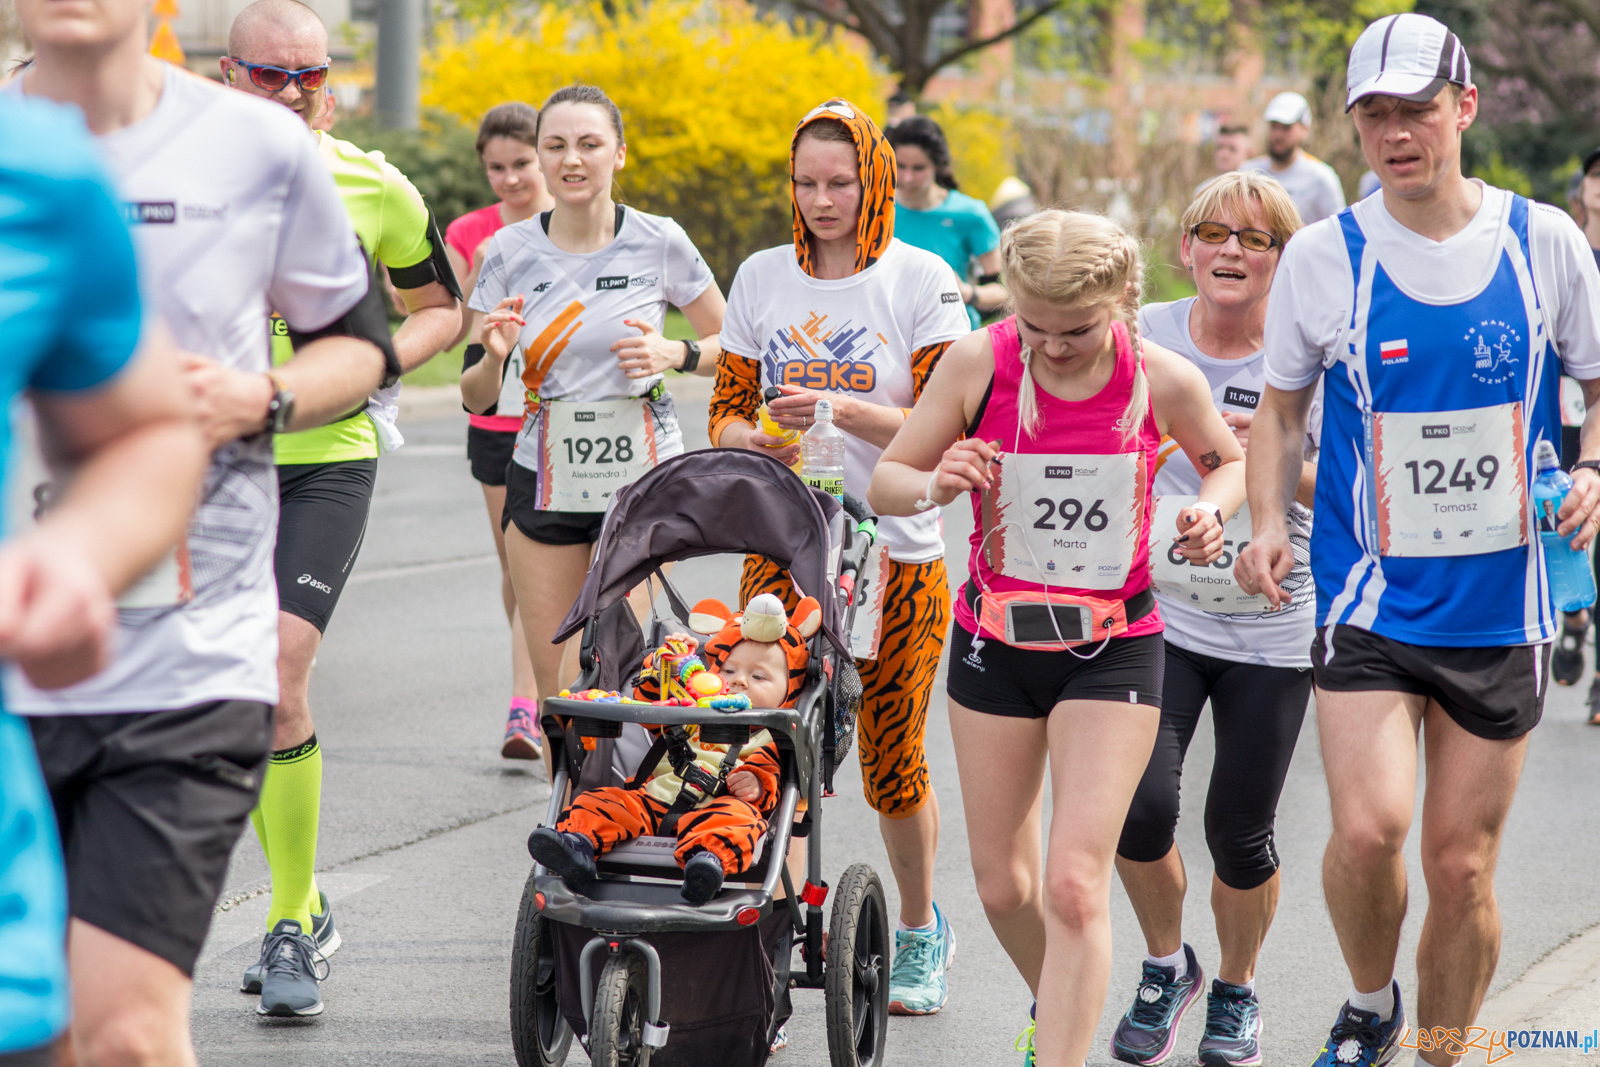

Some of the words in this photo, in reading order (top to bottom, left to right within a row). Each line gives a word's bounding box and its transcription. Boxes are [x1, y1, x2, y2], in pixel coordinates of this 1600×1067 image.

[1463, 327, 1476, 342] KB
[1481, 319, 1521, 342] MANIAC
[1382, 357, 1409, 366] POLAND
[1229, 391, 1257, 404] 11.PKO
[1425, 427, 1449, 435] 11.PKO
[563, 435, 634, 464] 1928
[572, 470, 620, 479] Aleksandra
[1048, 468, 1071, 476] 11.PKO
[1404, 454, 1500, 495] 1249
[1433, 502, 1478, 513] Tomasz
[1033, 497, 1109, 532] 296
[1459, 529, 1474, 538] 4F
[1053, 539, 1087, 549] Marta
[1190, 574, 1231, 585] Barbara
[309, 578, 332, 594] asics
